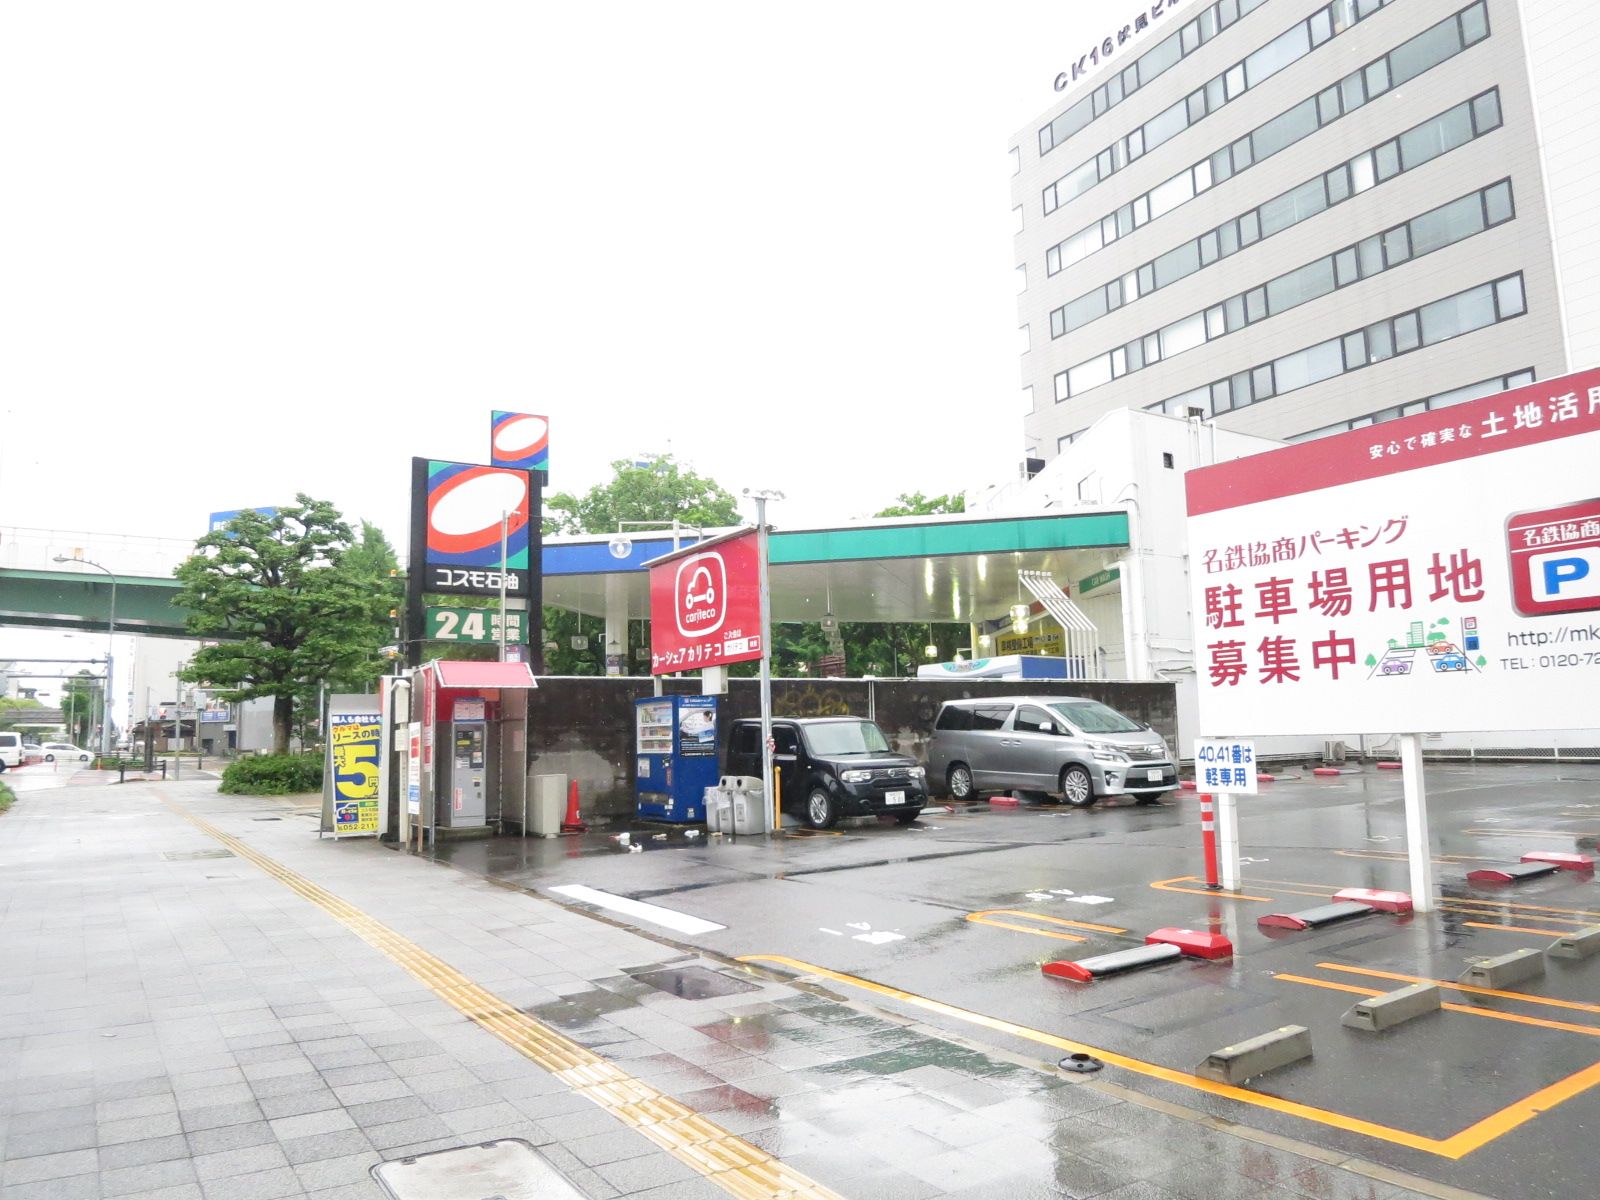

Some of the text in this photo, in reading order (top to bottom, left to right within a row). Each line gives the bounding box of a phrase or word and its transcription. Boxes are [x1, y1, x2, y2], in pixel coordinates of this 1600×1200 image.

[1369, 423, 1473, 460] 安心で確実な
[1202, 515, 1409, 575] 名鉄協商パーキング
[1523, 520, 1600, 547] 名鉄協商
[436, 568, 519, 590] コスモ石油
[1204, 547, 1485, 630] 駐車場用地
[1542, 557, 1590, 595] P
[435, 611, 486, 640] 24
[1207, 629, 1357, 688] 募集中
[1198, 744, 1252, 764] 40,41番は
[1205, 767, 1247, 787] 軽専用
